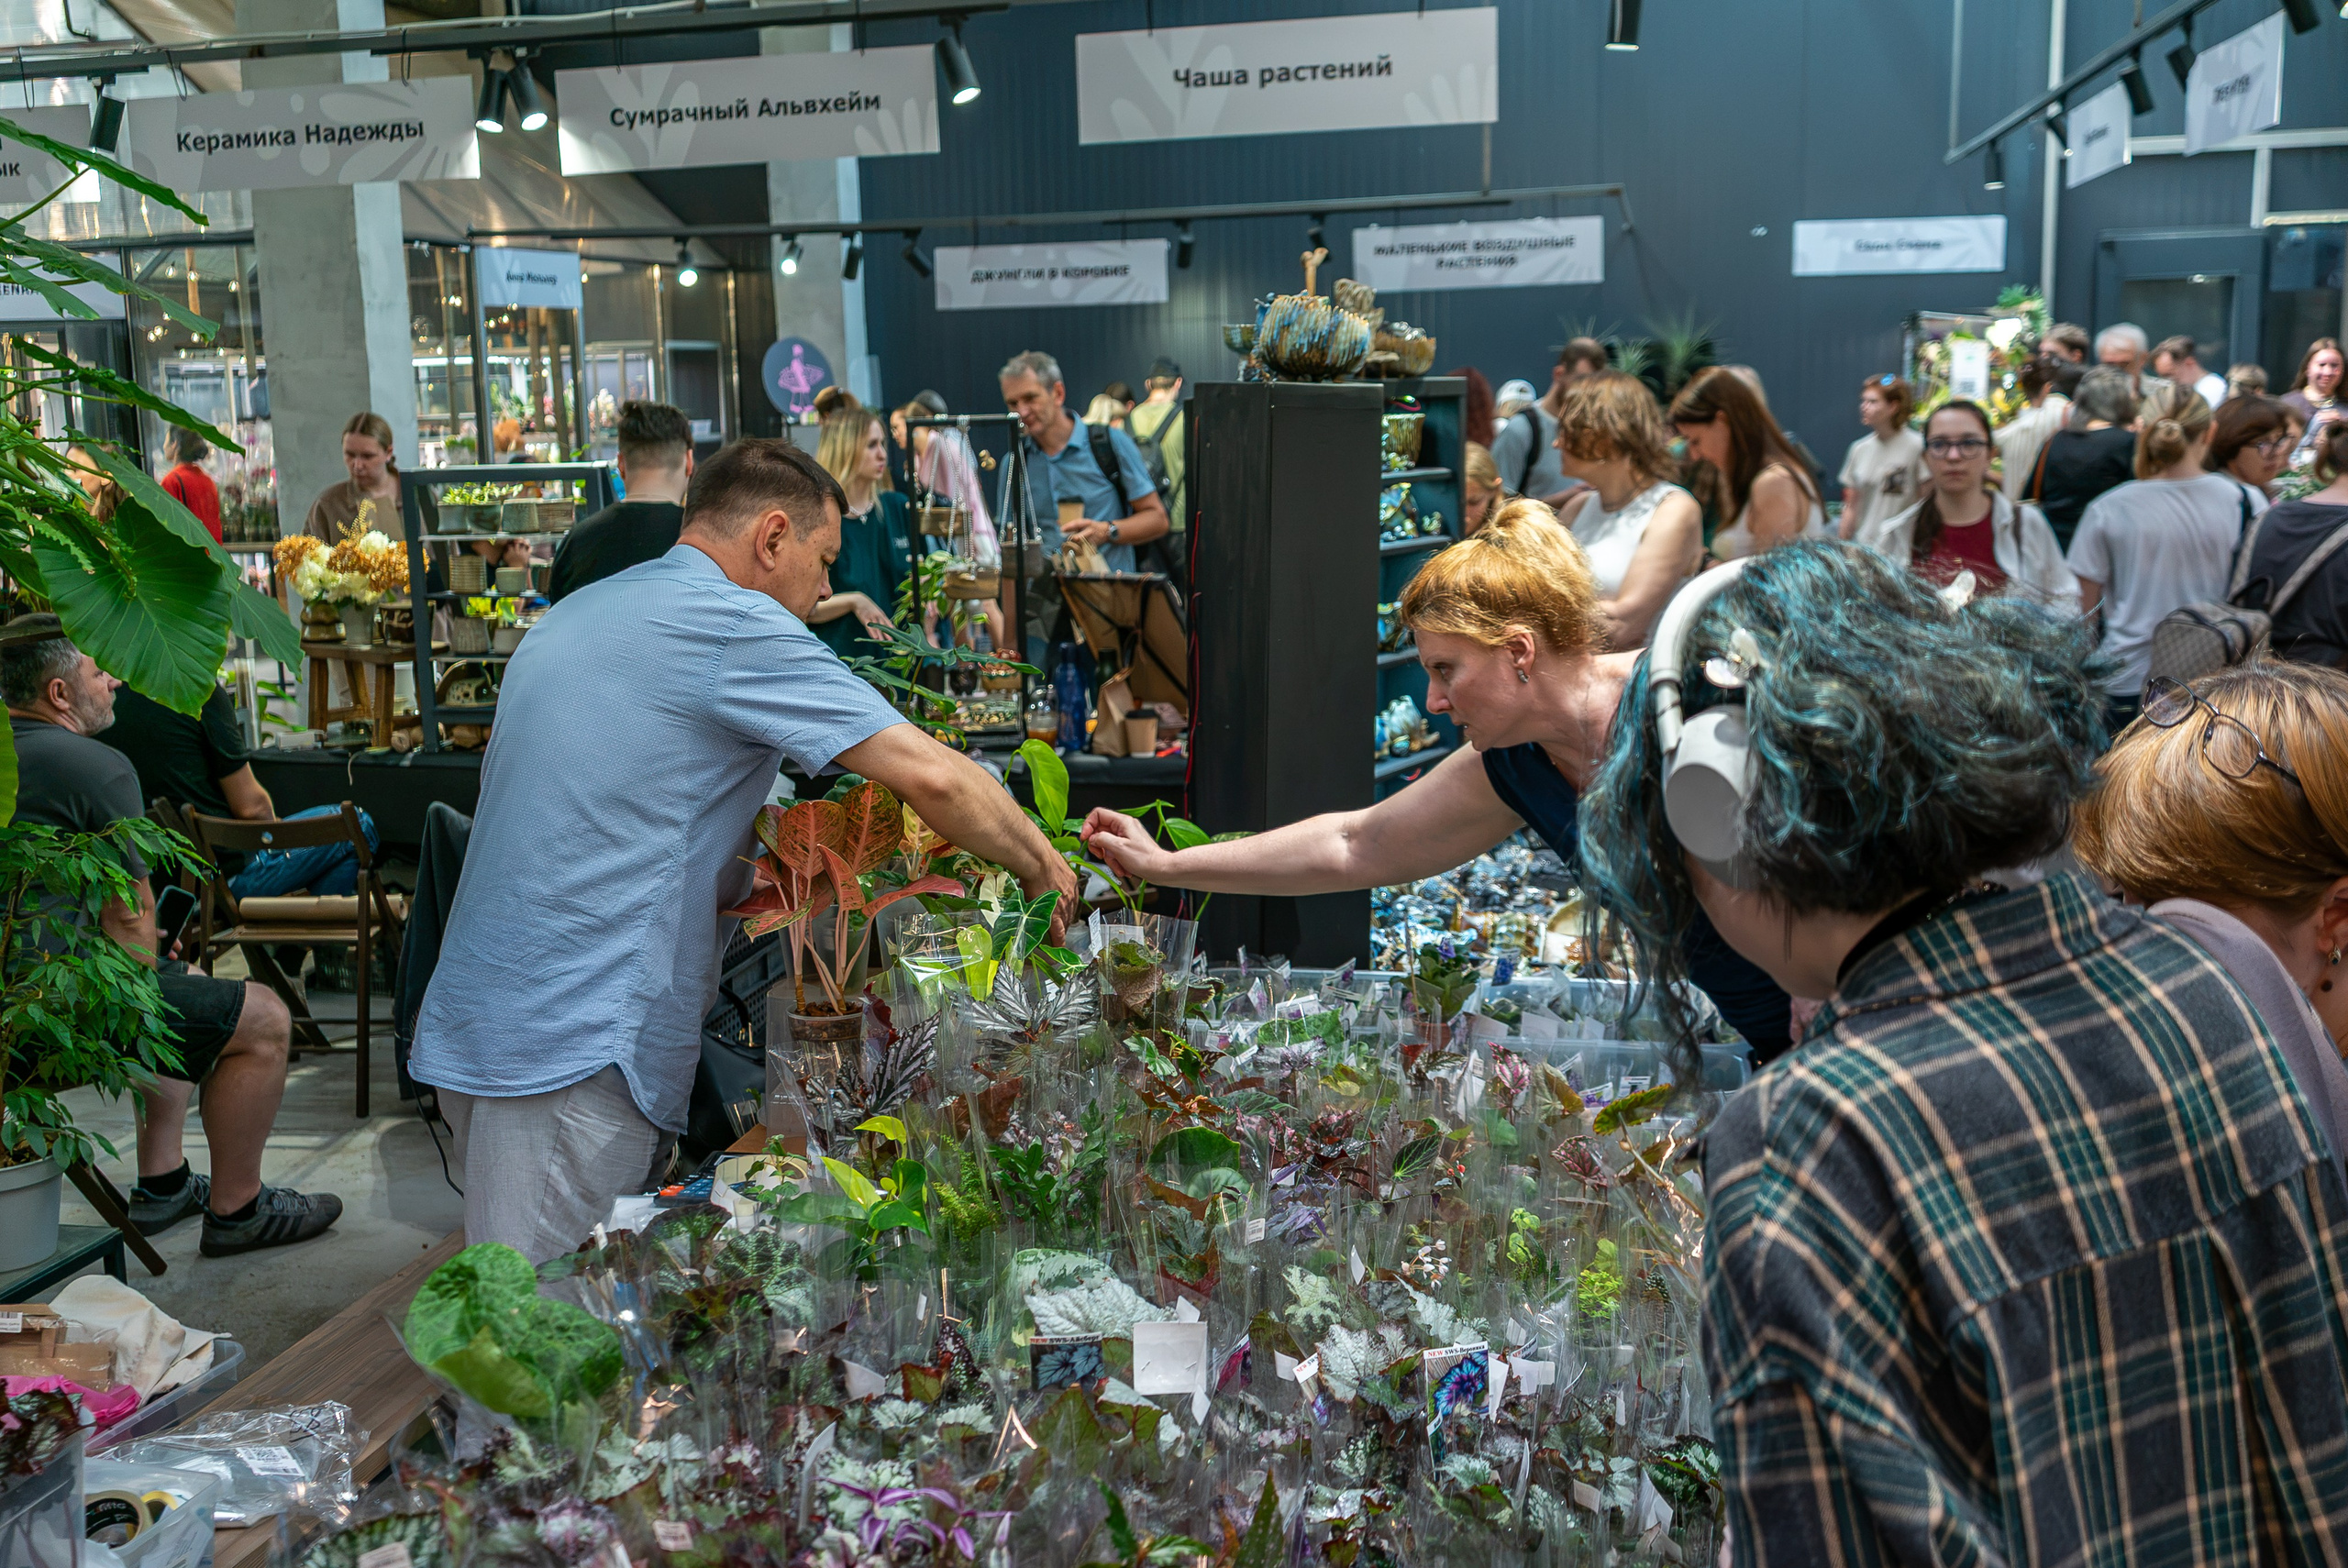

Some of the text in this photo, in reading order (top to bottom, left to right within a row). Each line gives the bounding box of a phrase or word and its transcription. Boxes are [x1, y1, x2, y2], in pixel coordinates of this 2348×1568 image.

[1173, 53, 1393, 89] Чаша растений
[609, 90, 881, 130] Сумрачный Альвхейм
[176, 121, 424, 156] Керамика Надежды
[1374, 235, 1575, 256] МАЛЕНЬКИЕ ВОЗДУШНЫЕ
[970, 264, 1130, 285] ДЖУНГЛИ В КОРОБКЕ
[1435, 254, 1518, 271] РАСТЕНИЯ
